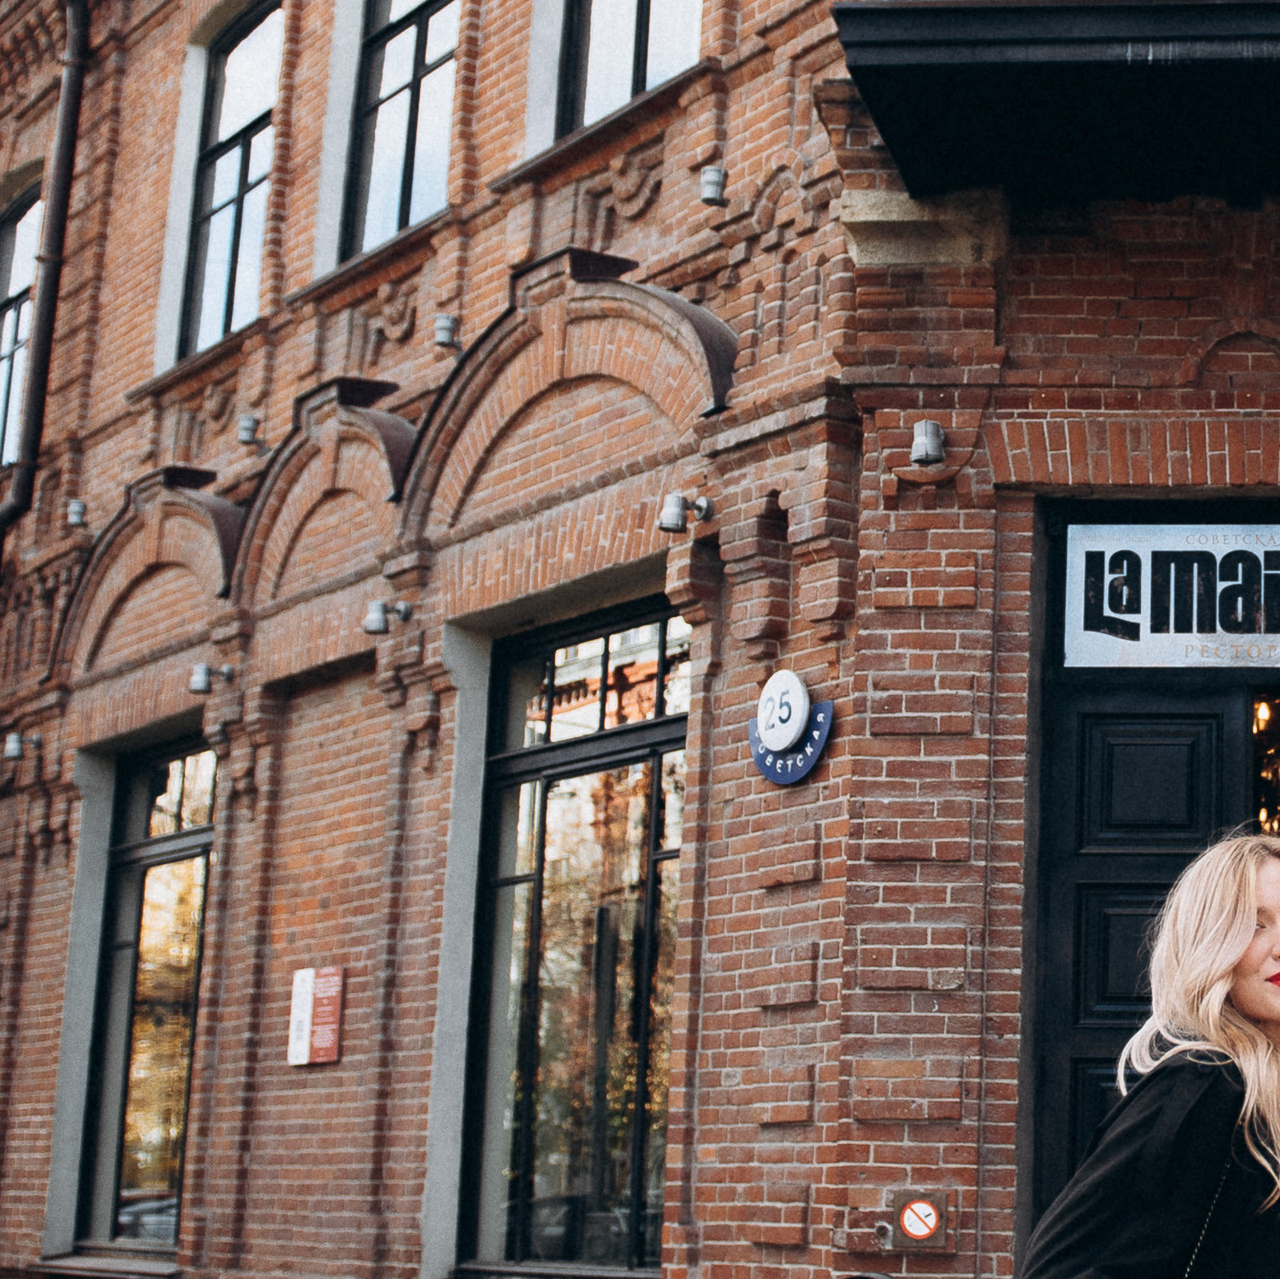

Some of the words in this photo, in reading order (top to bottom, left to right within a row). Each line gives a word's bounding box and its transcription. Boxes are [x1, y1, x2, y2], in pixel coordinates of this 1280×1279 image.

[1083, 549, 1142, 641] La
[764, 690, 792, 730] 25
[755, 713, 825, 773] ОВЕТСКАЯ
